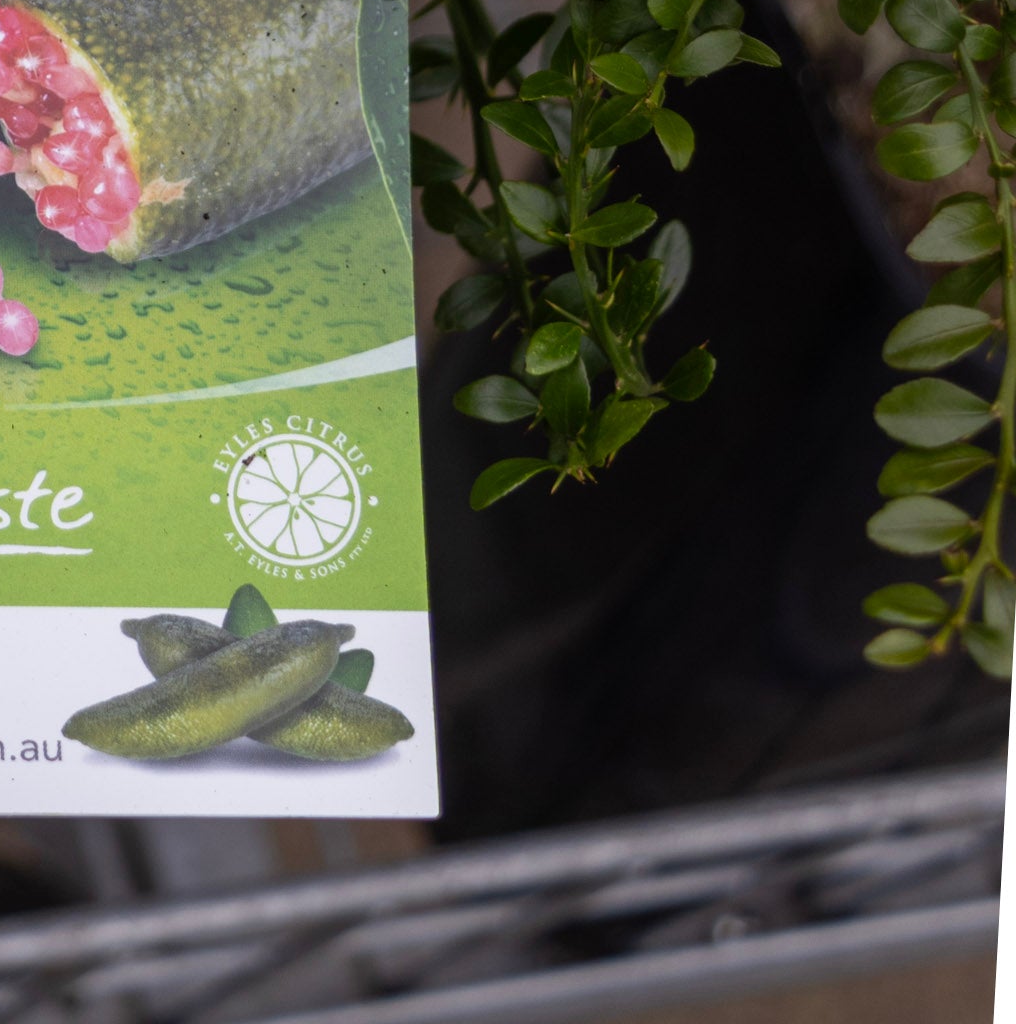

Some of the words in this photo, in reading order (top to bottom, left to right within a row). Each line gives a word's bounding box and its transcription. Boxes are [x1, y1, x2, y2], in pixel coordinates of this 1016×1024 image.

[213, 418, 274, 473] EYLES
[286, 415, 373, 476] CITRUS
[248, 554, 288, 579] EYLES
[294, 569, 305, 581] &
[310, 557, 346, 579] SONS
